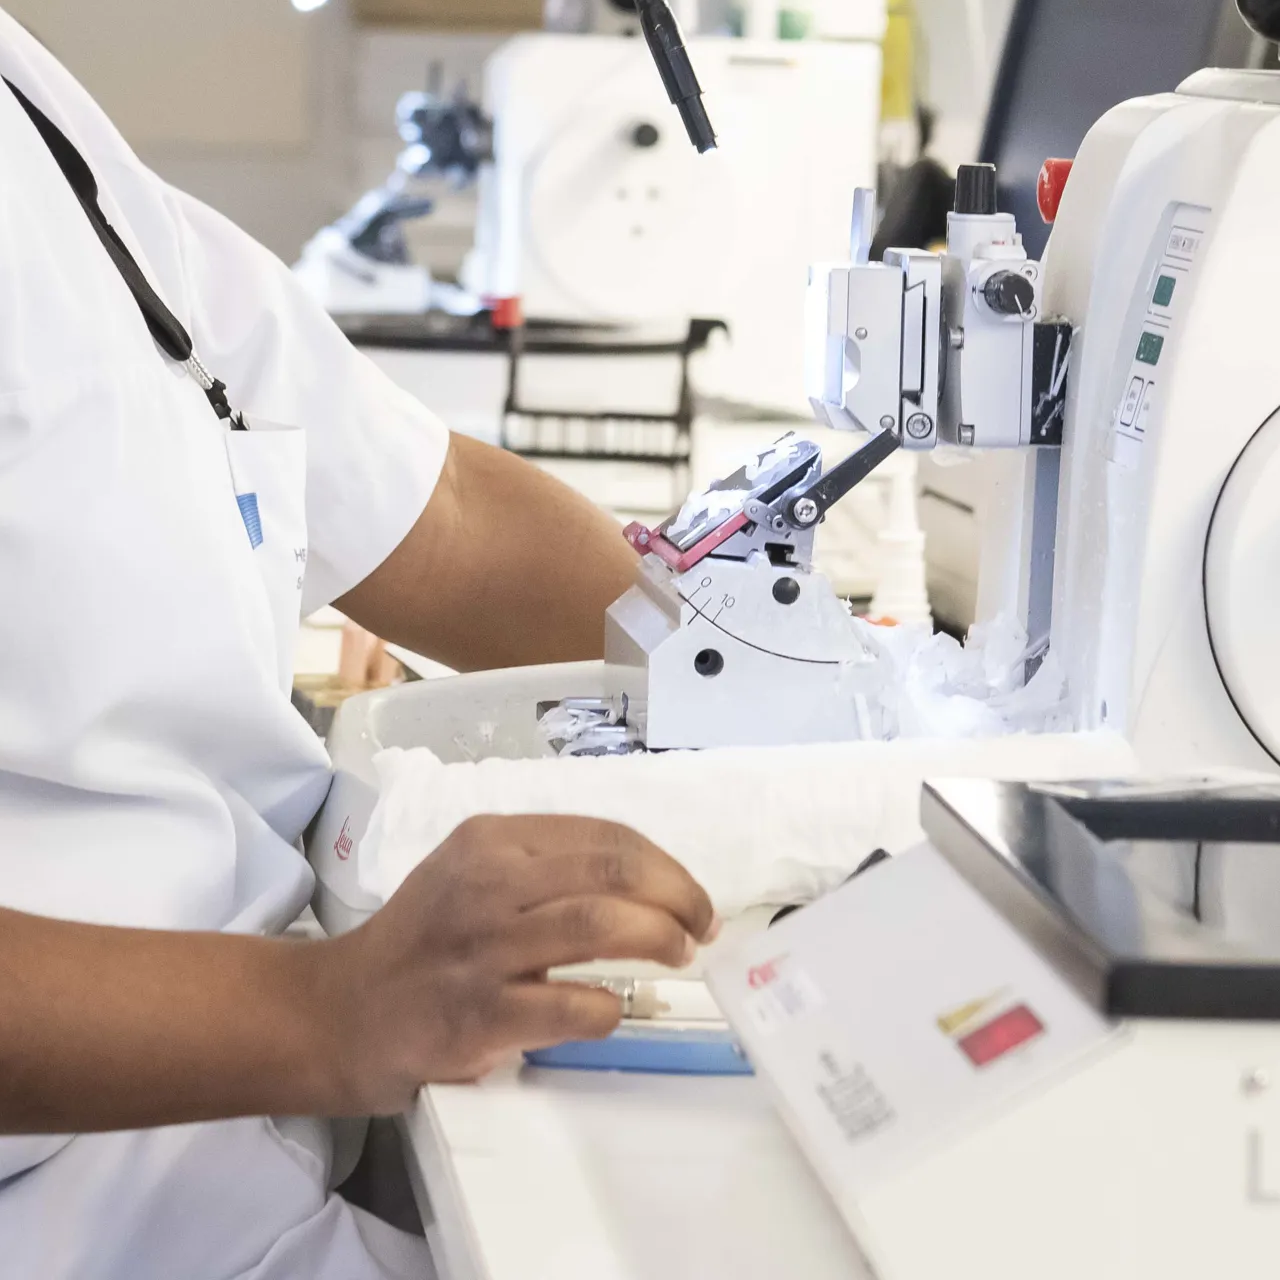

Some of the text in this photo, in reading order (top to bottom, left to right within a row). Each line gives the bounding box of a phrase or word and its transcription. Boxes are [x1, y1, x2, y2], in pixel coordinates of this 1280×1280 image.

[701, 576, 712, 588] 0
[720, 593, 736, 608] 10
[334, 815, 353, 861] Leica
